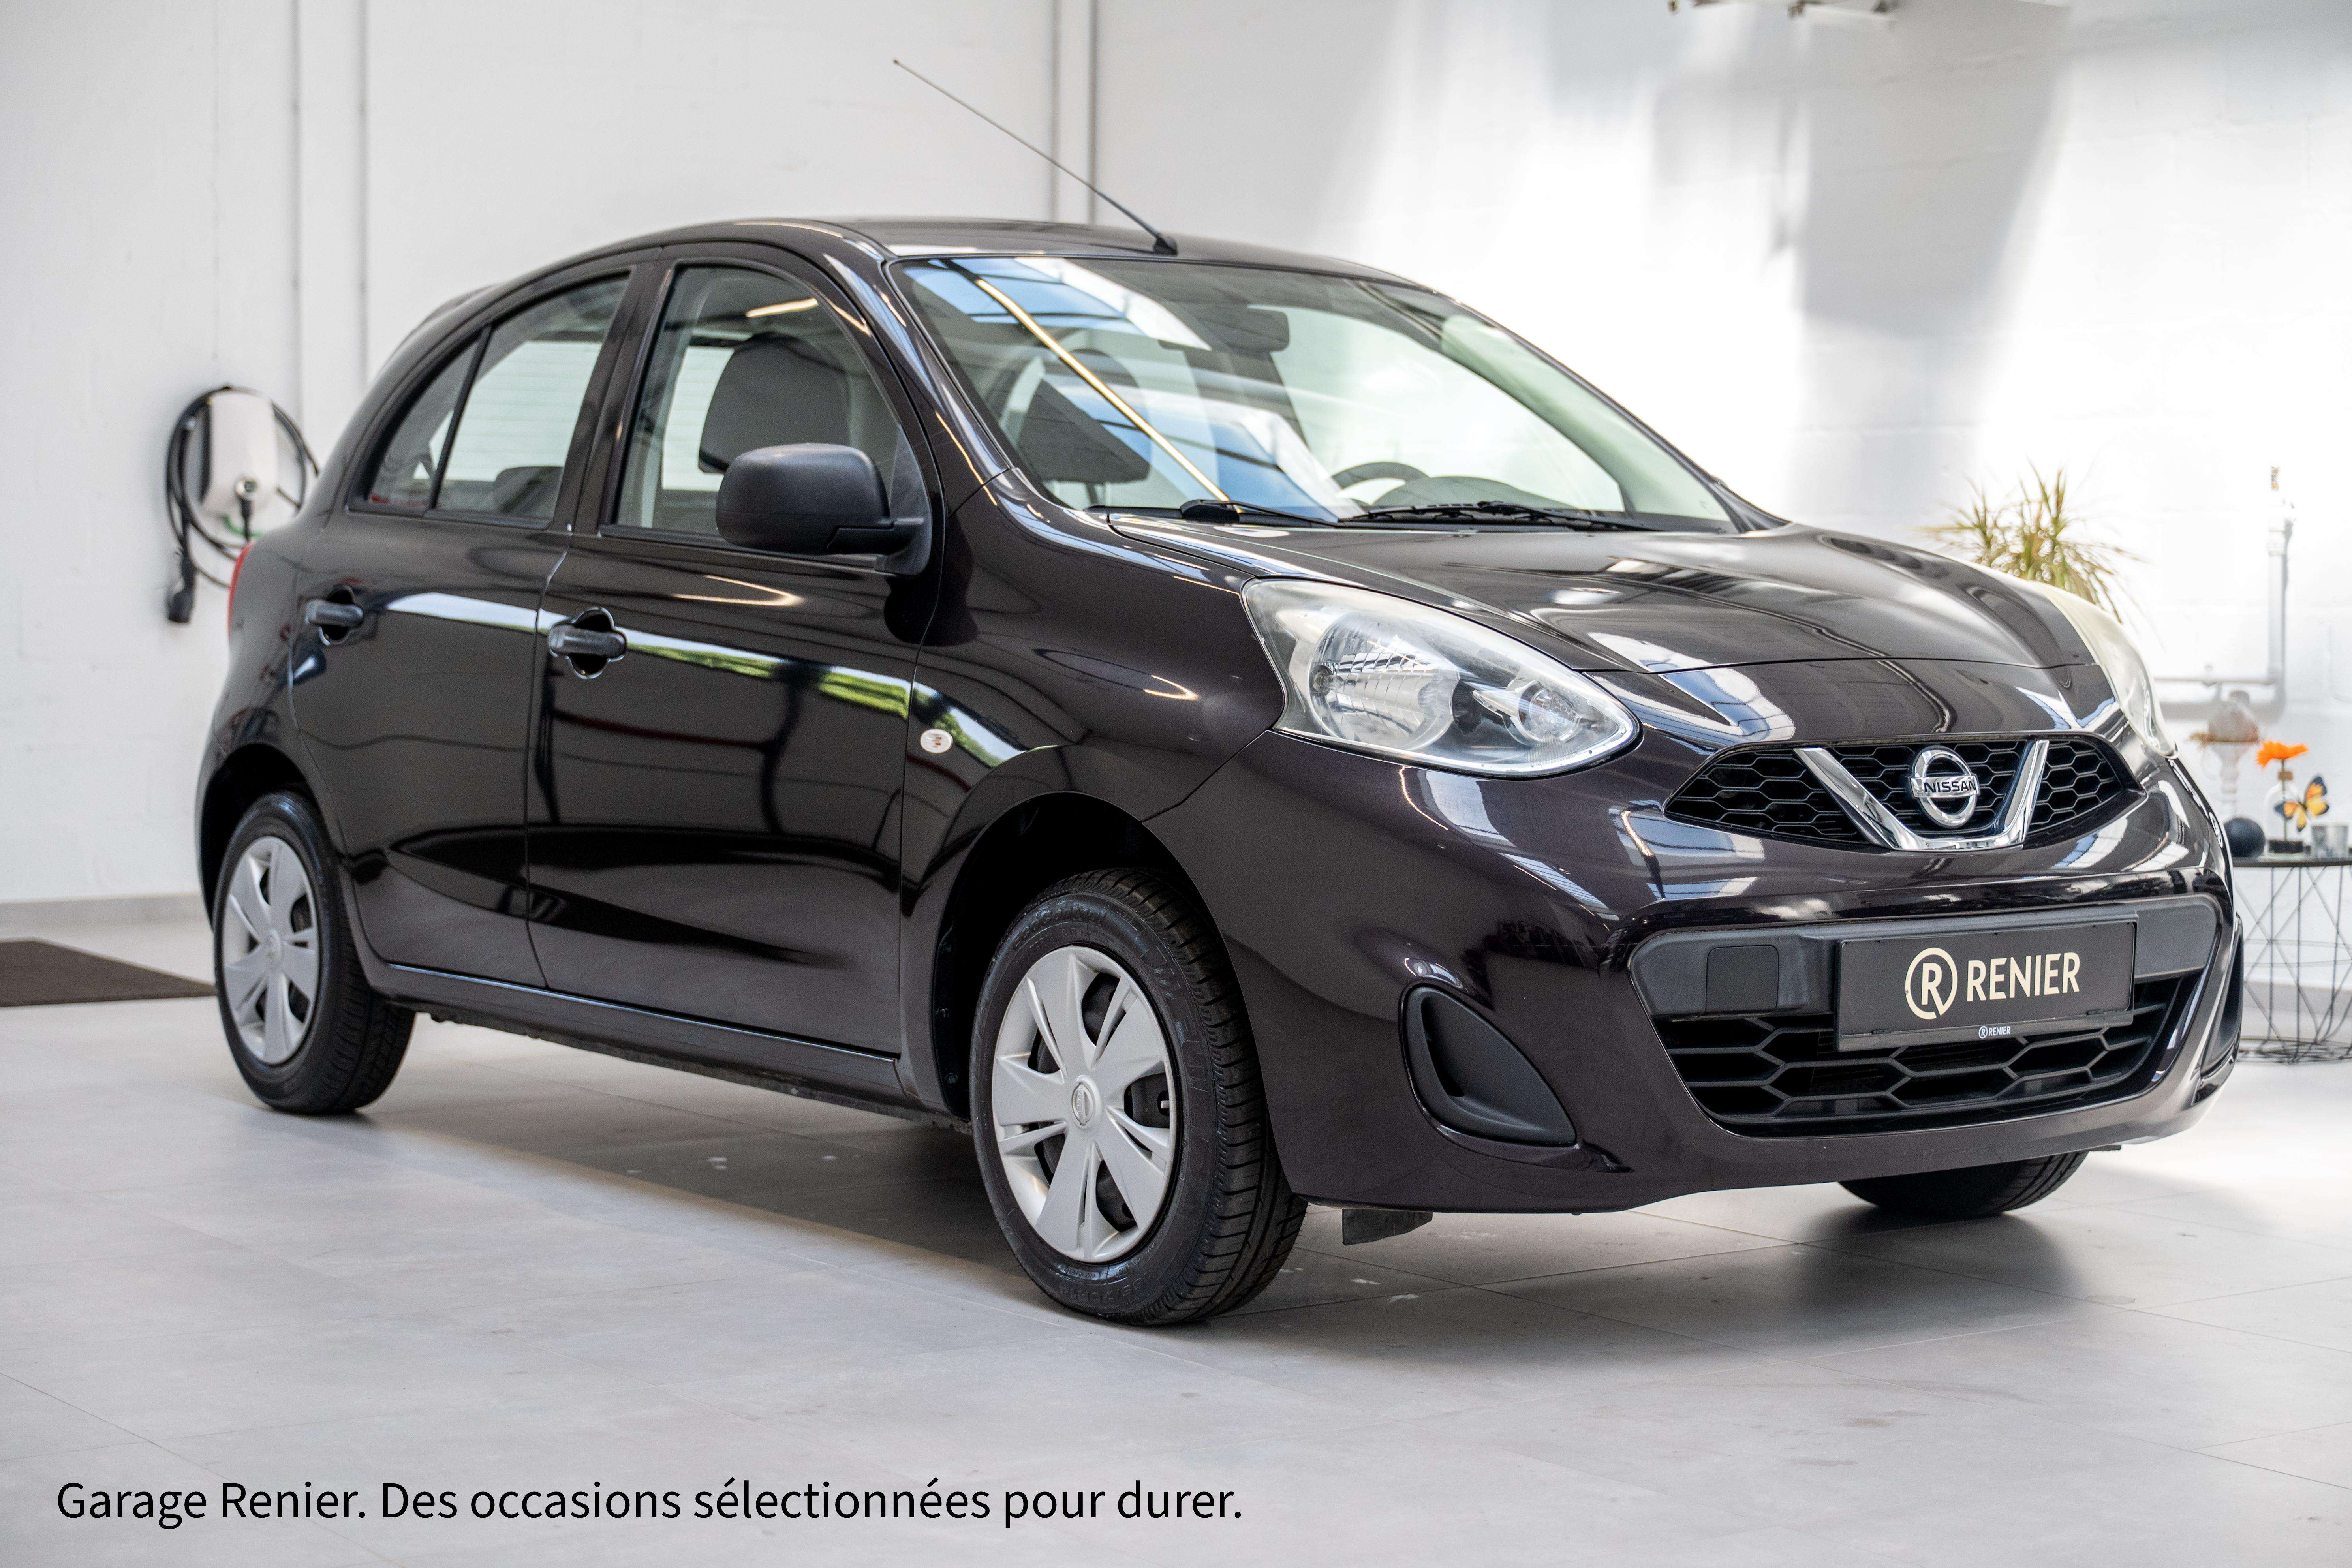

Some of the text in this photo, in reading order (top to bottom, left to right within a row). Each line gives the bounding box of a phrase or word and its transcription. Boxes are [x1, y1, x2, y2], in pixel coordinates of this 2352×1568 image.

[1923, 779, 1976, 793] NISSAN
[1967, 952, 2080, 1001] RENIER
[1988, 1026, 2011, 1037] RENIER
